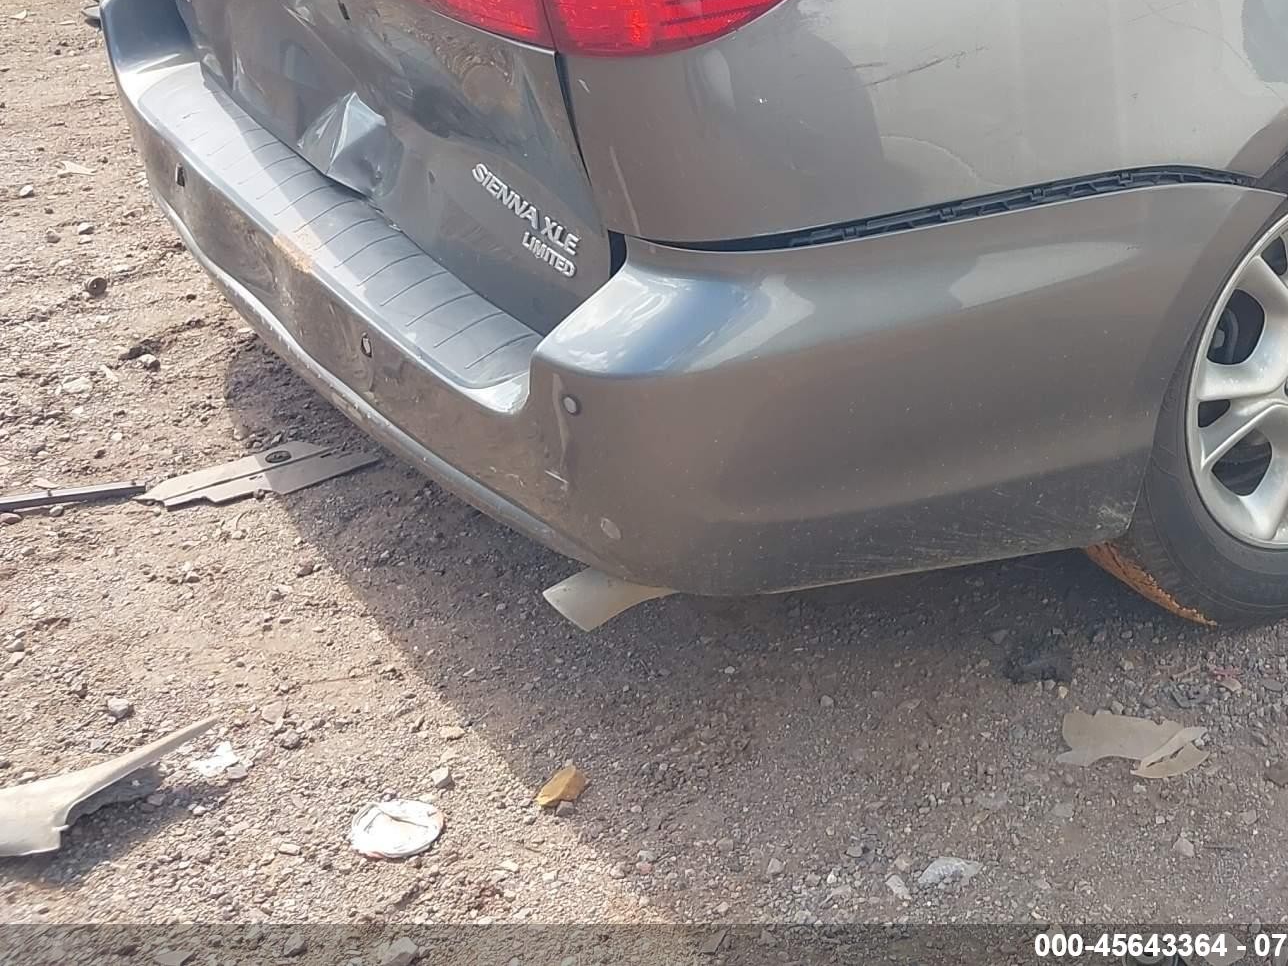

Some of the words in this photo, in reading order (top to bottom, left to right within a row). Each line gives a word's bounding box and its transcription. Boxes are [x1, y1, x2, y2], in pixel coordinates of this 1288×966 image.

[471, 163, 539, 230] SIENNA
[540, 216, 580, 256] XLE
[521, 231, 576, 277] LIMITED
